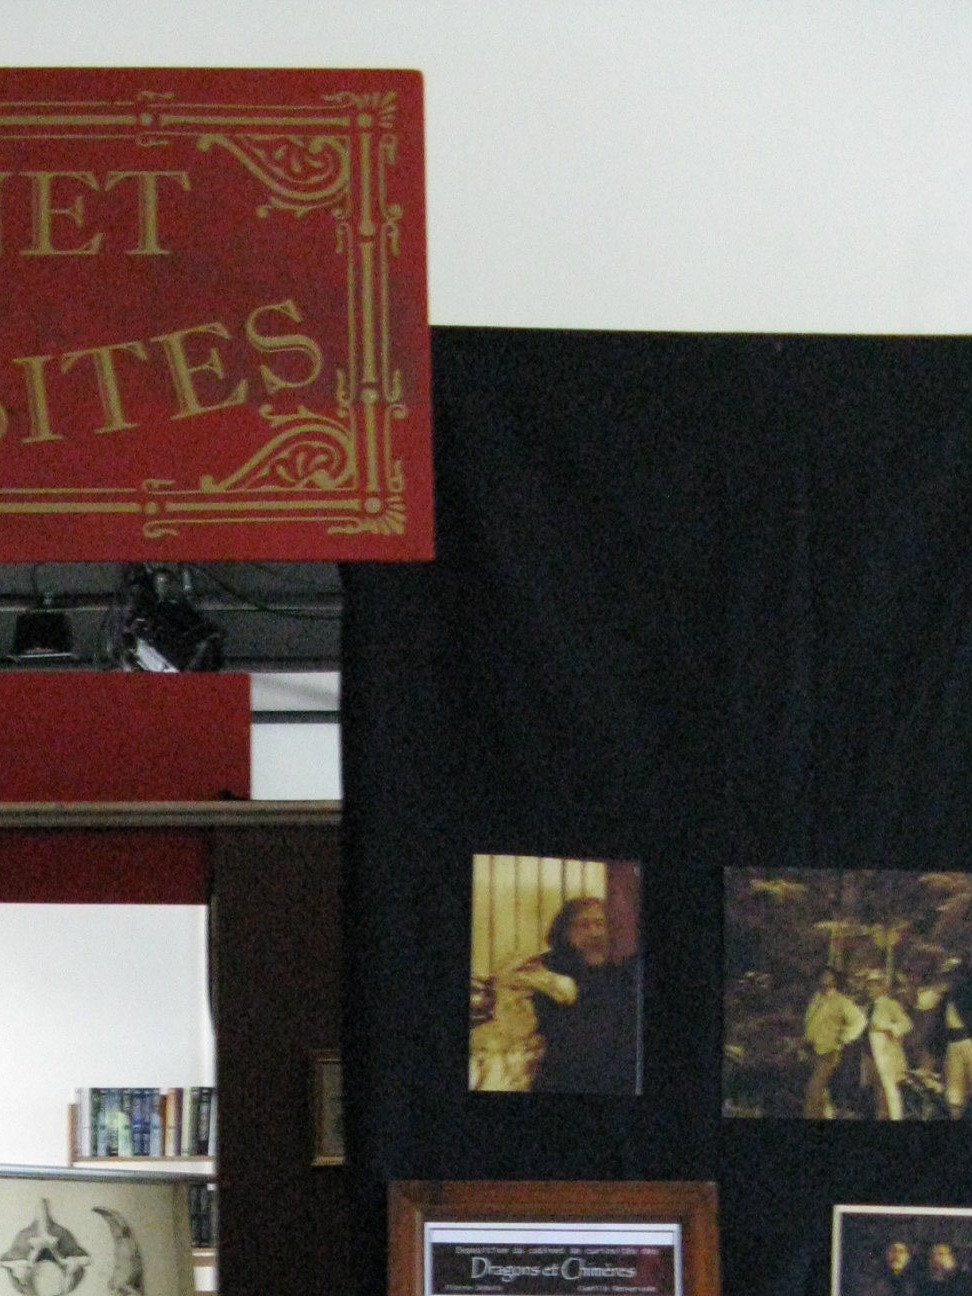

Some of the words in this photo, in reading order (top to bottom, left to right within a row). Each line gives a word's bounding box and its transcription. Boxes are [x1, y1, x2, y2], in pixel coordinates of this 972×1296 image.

[471, 1256, 541, 1283] Dragons
[542, 1265, 558, 1276] et
[561, 1257, 637, 1280] Chimères
